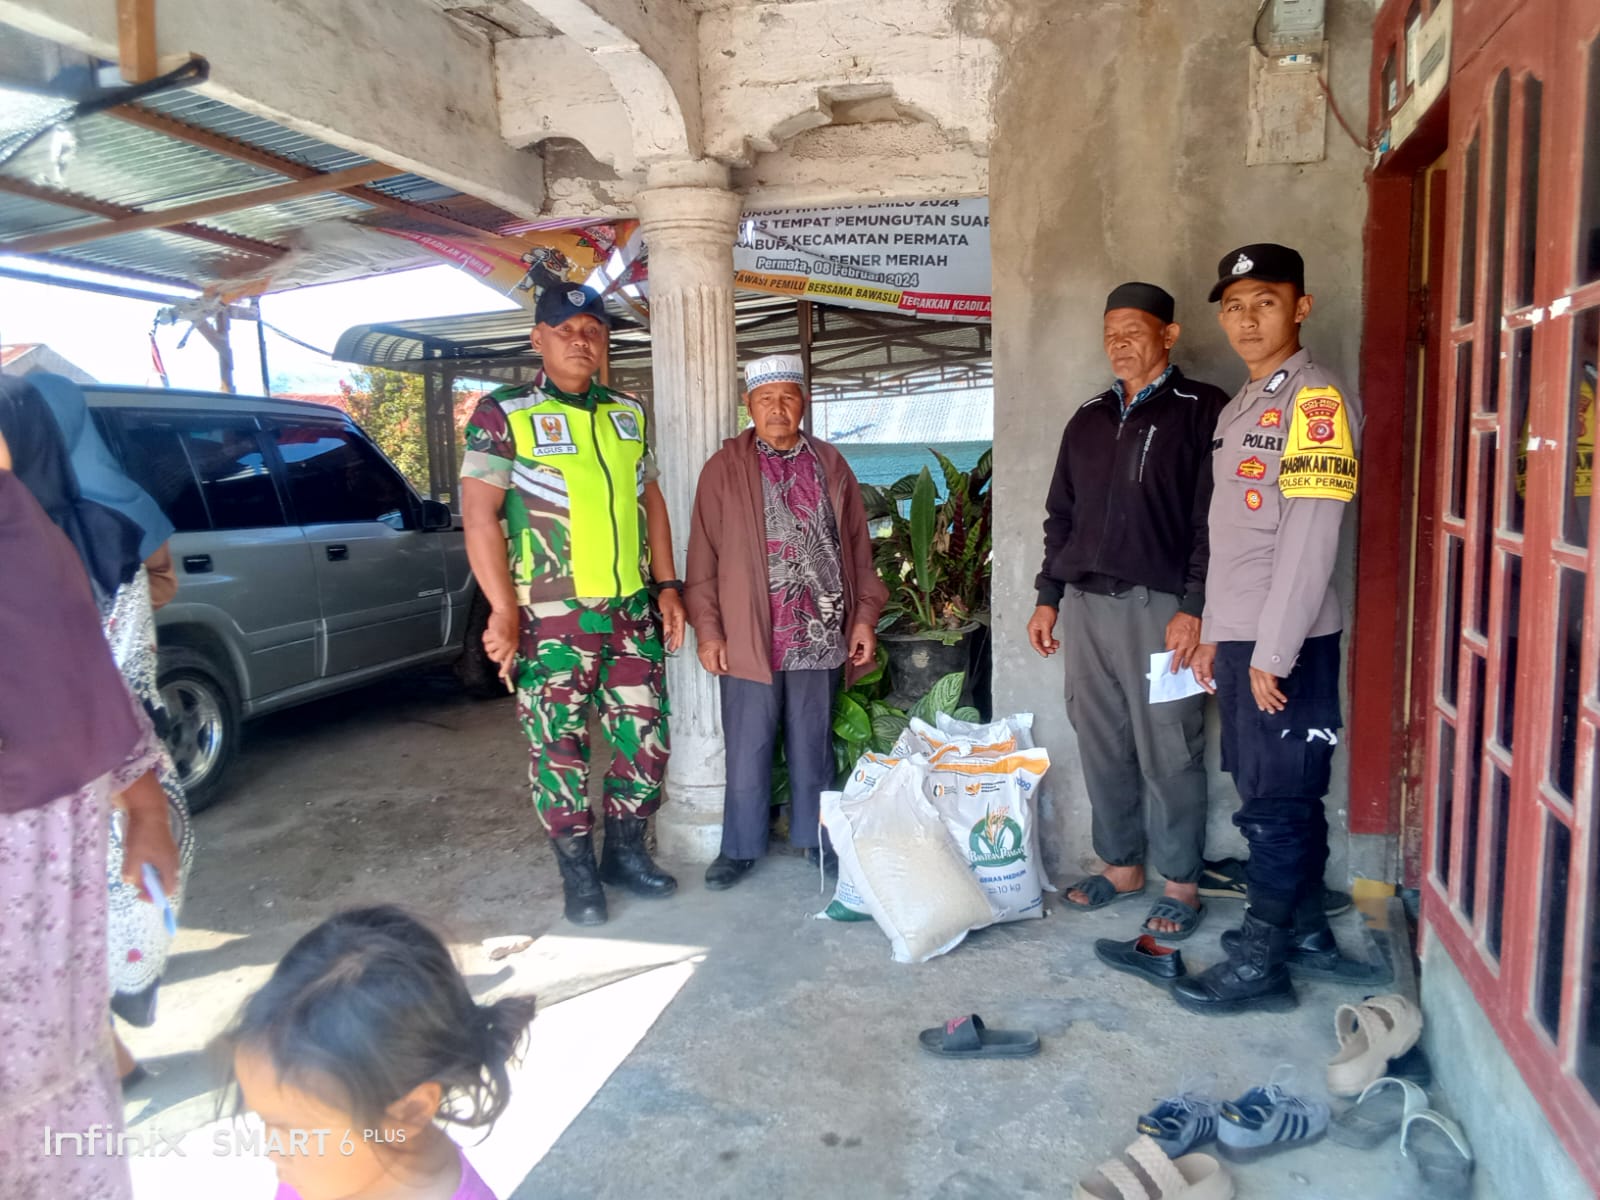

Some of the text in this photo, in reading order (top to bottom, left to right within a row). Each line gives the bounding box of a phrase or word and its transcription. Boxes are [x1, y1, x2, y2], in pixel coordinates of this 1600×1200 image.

[774, 216, 832, 229] TEMPAT
[836, 214, 946, 227] PEMUNGUTAN
[792, 232, 889, 246] KECAMATAN
[893, 232, 969, 246] PERMATA
[886, 254, 948, 267] MERIAH
[757, 257, 812, 275] Permata,
[813, 260, 832, 275] 08
[886, 272, 920, 288] 2024
[769, 278, 807, 291] PEMILU
[807, 281, 854, 297] BERSAMA
[855, 288, 901, 304] BAWASLU
[1242, 433, 1284, 452] POLRI
[537, 447, 564, 455] AGUS
[1315, 477, 1354, 490] PERMATA
